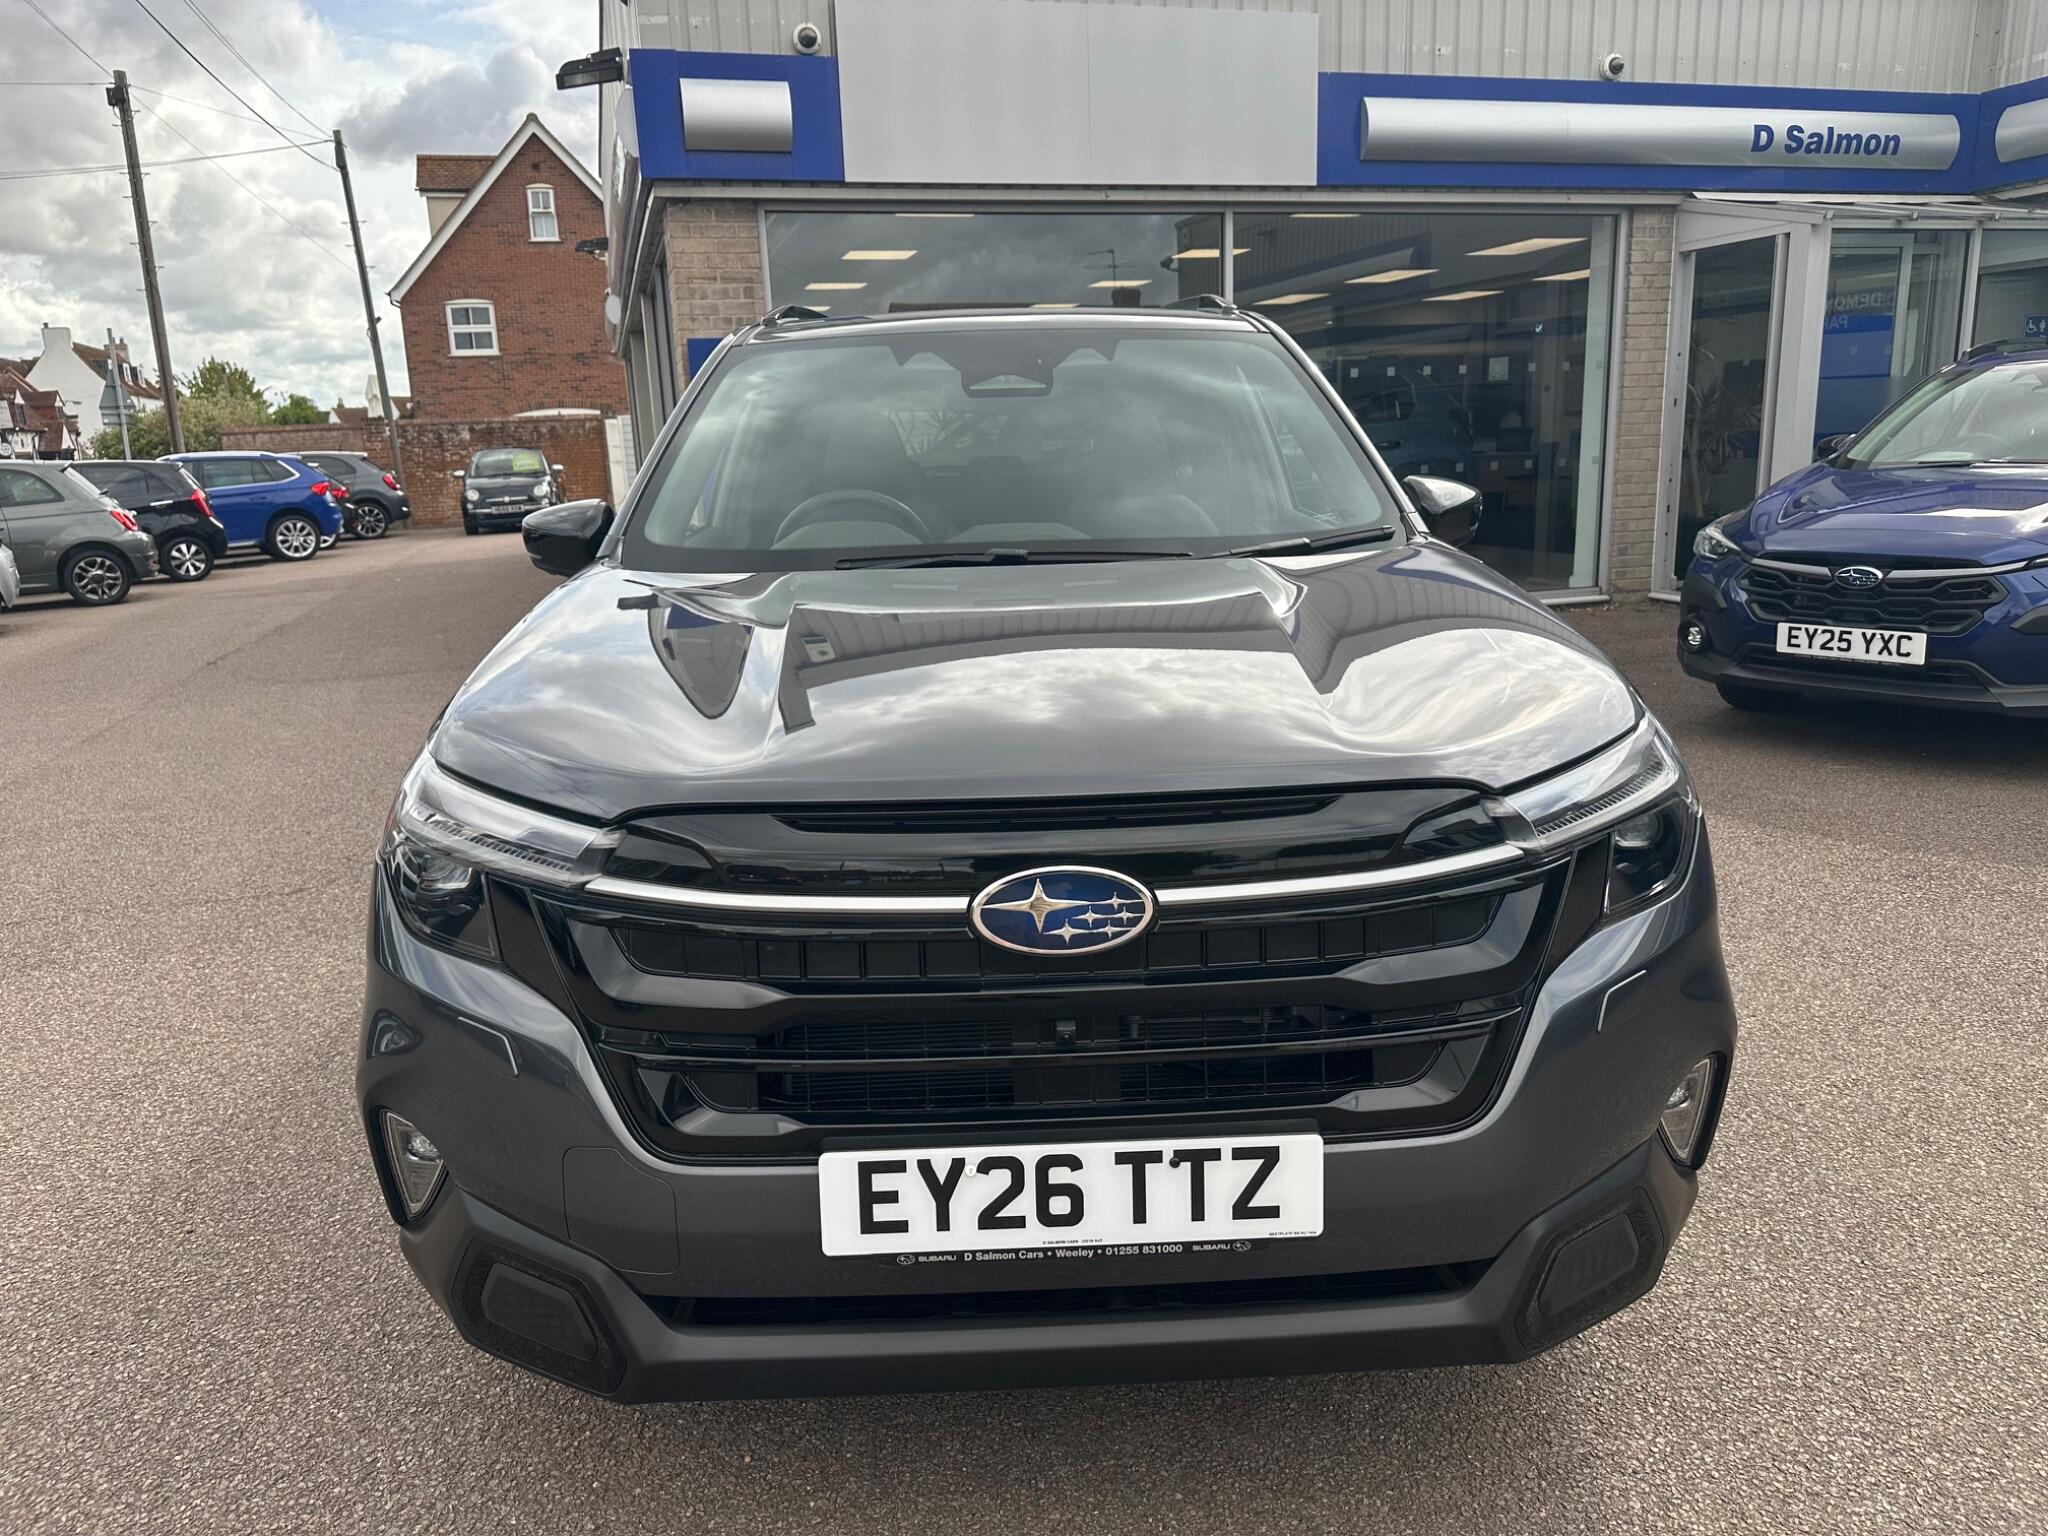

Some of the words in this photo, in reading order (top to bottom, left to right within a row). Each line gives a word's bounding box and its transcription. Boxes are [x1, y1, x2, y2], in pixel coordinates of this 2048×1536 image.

[1751, 124, 1774, 152] D
[1784, 124, 1901, 156] Salmon
[1787, 626, 1852, 652] EY25
[1861, 631, 1913, 658] YXC
[858, 1153, 1084, 1234] EY26
[1115, 1146, 1280, 1224] TTZ
[918, 1255, 957, 1263] SUBARU
[964, 1253, 972, 1262] D
[975, 1252, 1016, 1261] Salmon
[1018, 1250, 1044, 1259] Cars
[1055, 1247, 1094, 1258] Weeley
[1105, 1246, 1140, 1256] 01255
[1142, 1244, 1183, 1254] 831000
[1192, 1243, 1231, 1251] SUBARU
